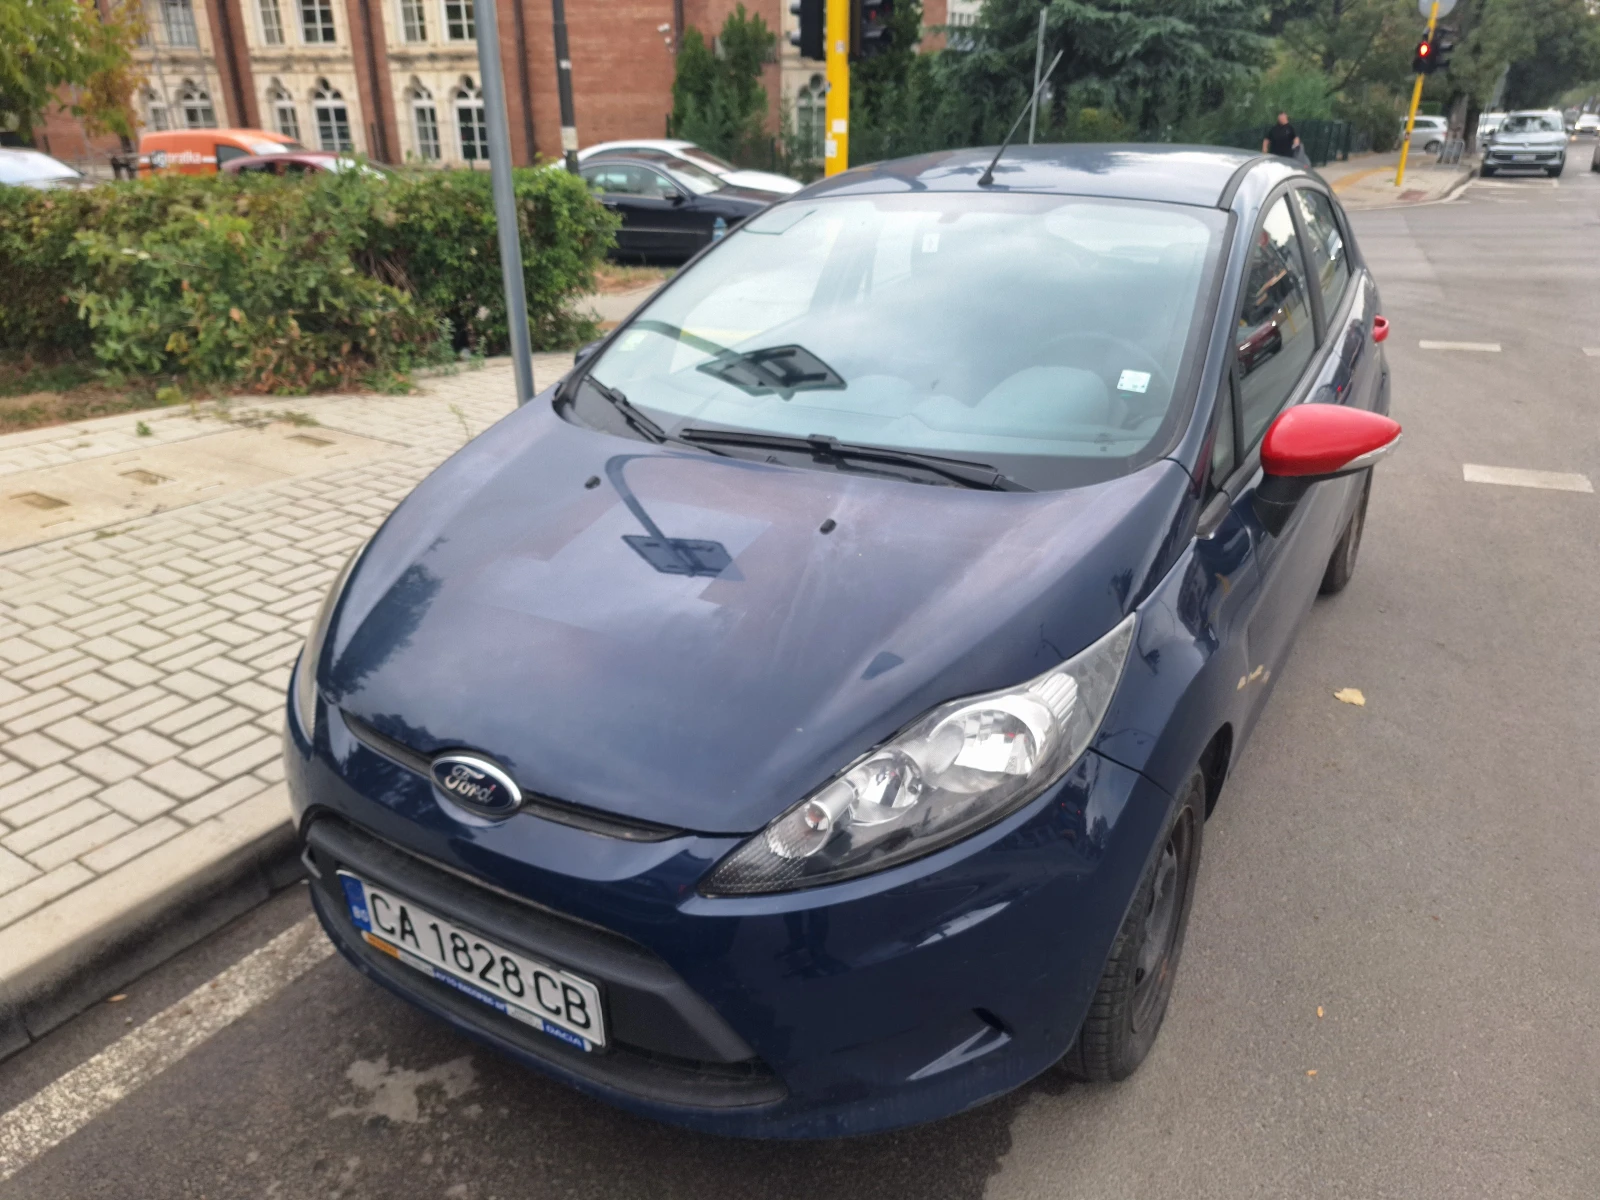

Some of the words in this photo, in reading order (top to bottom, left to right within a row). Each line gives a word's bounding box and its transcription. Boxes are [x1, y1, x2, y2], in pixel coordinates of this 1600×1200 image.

[444, 764, 497, 803] Ford
[370, 893, 421, 950] CA
[429, 922, 525, 998] 1828
[533, 970, 591, 1029] CB
[545, 1023, 583, 1048] DACIA
